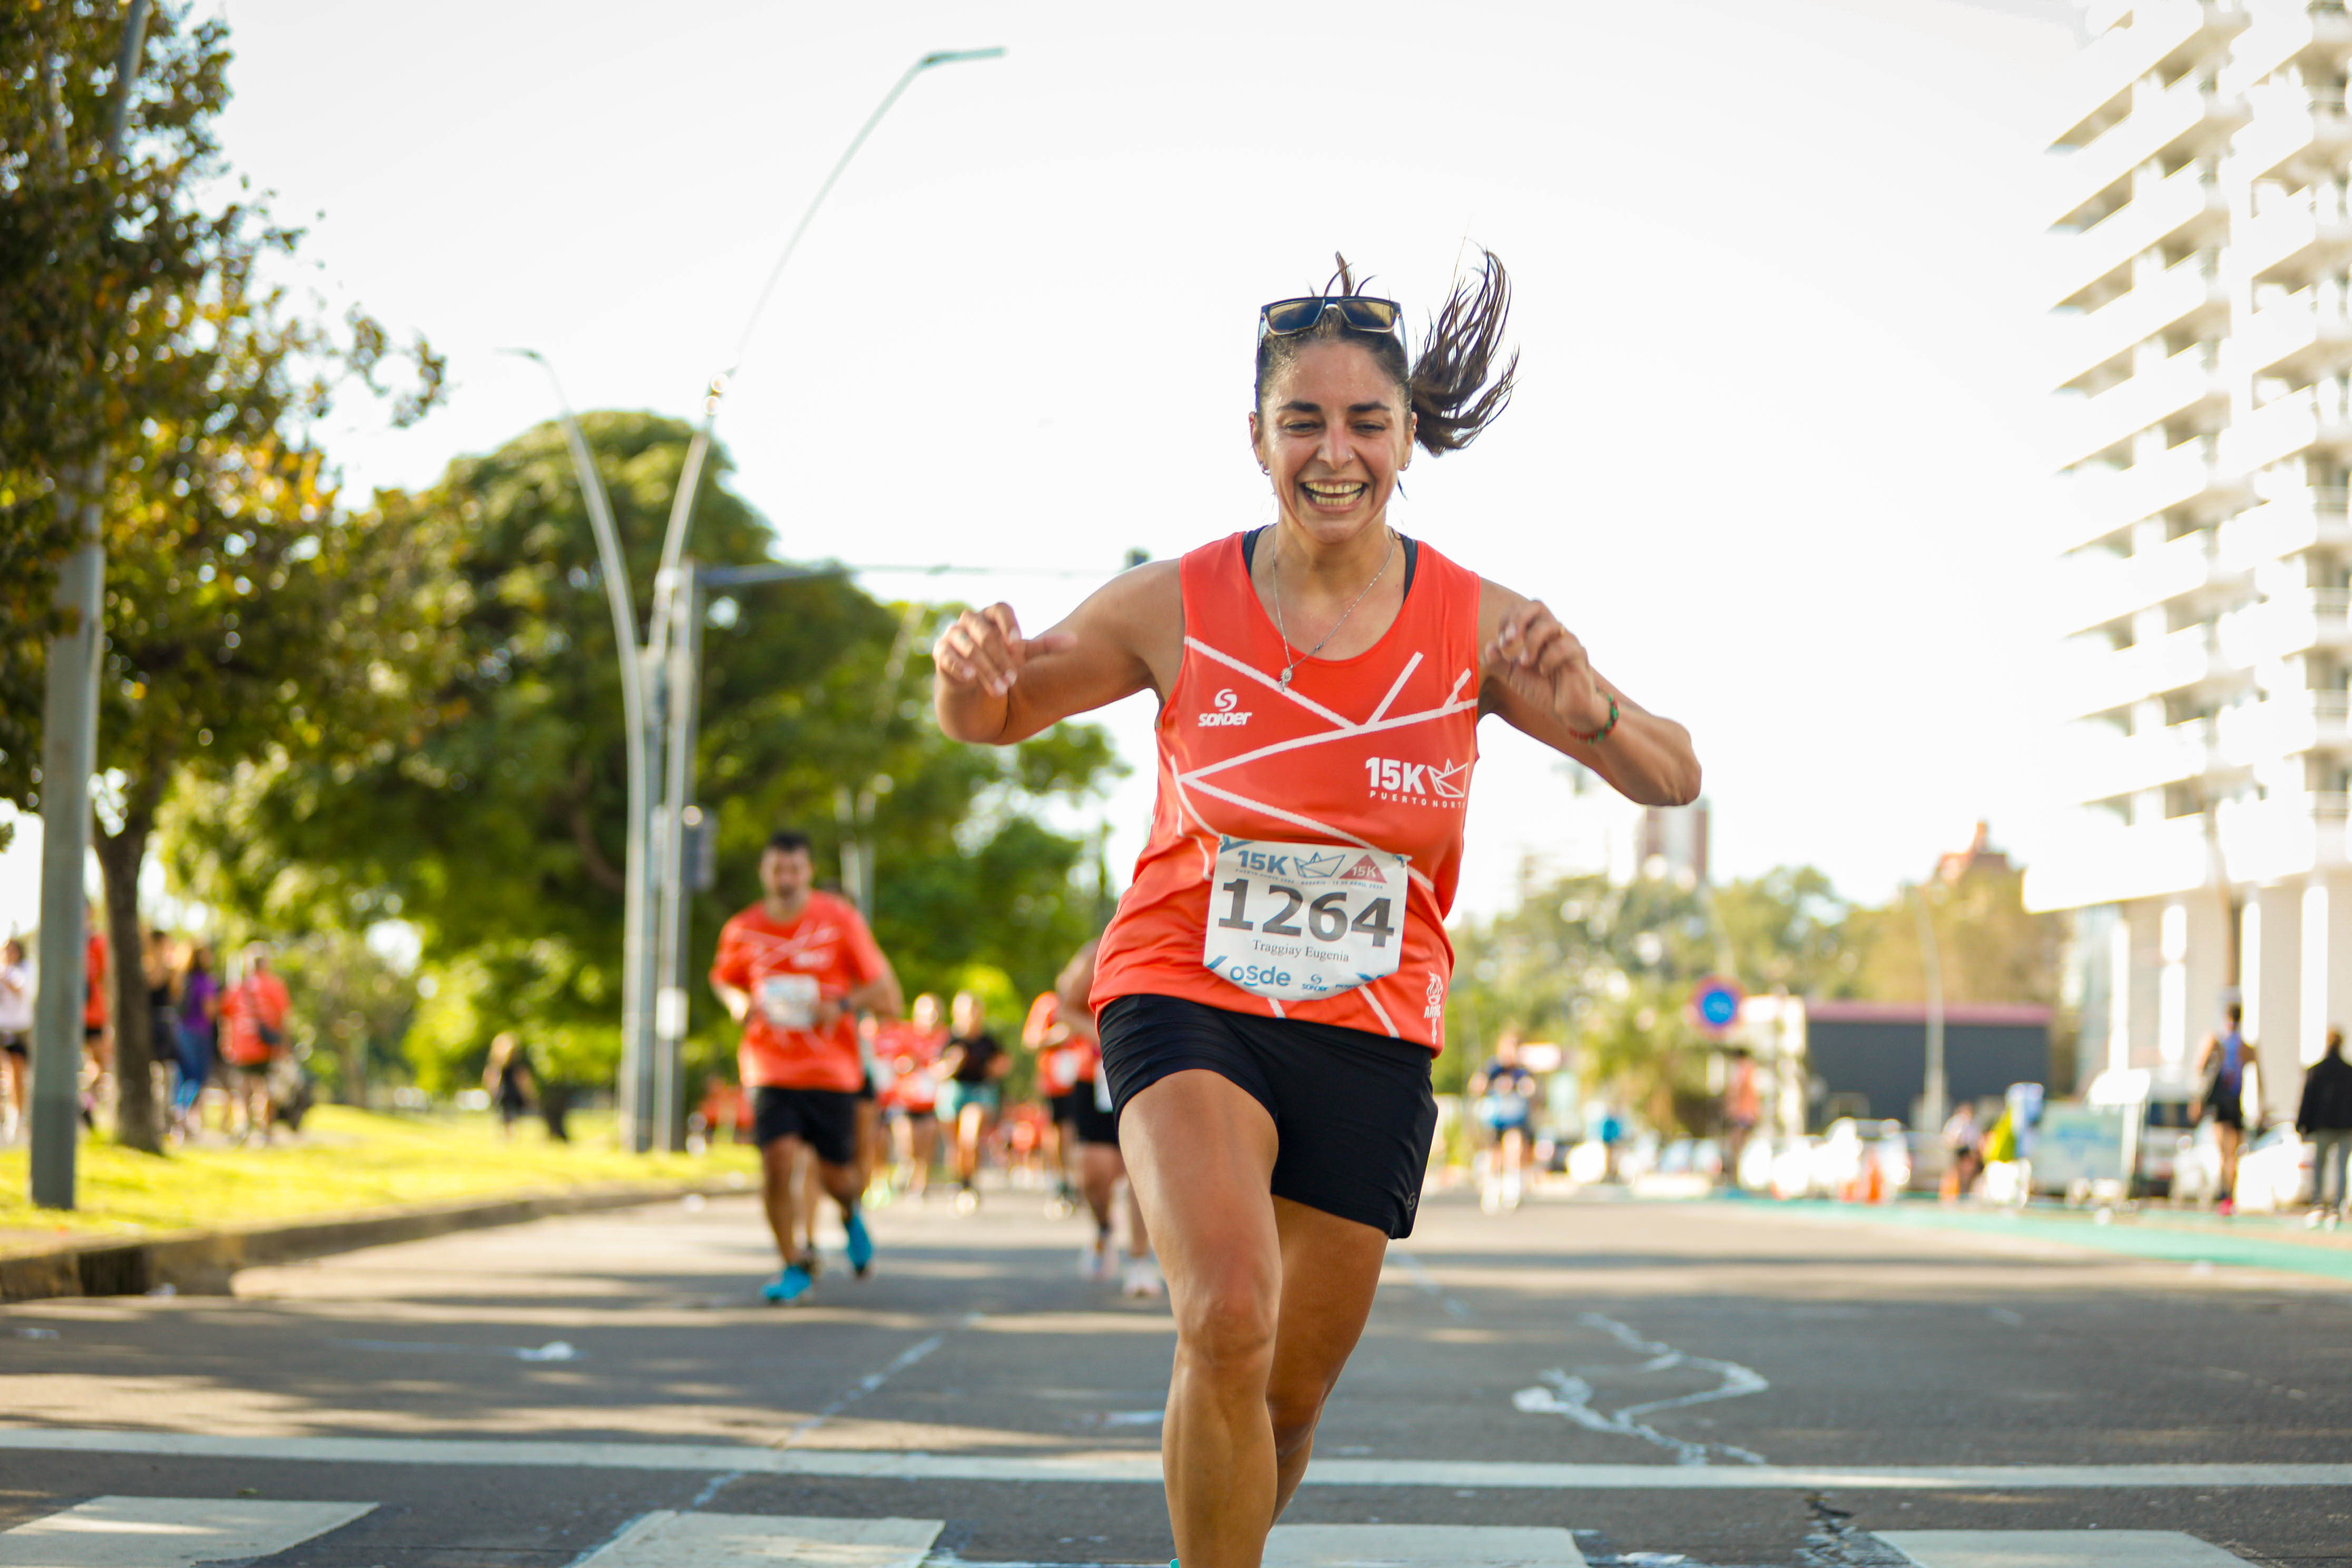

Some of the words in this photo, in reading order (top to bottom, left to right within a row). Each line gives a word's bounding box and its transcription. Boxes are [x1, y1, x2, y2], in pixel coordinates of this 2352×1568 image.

[1366, 757, 1426, 795] 15K
[1370, 790, 1427, 806] PUERTO
[1238, 850, 1289, 875] 15K
[1352, 866, 1377, 878] 15K
[1218, 878, 1395, 948] 1264
[1253, 939, 1301, 958] Traggiay
[1305, 946, 1349, 962] Eugenia
[1230, 965, 1291, 986] osde
